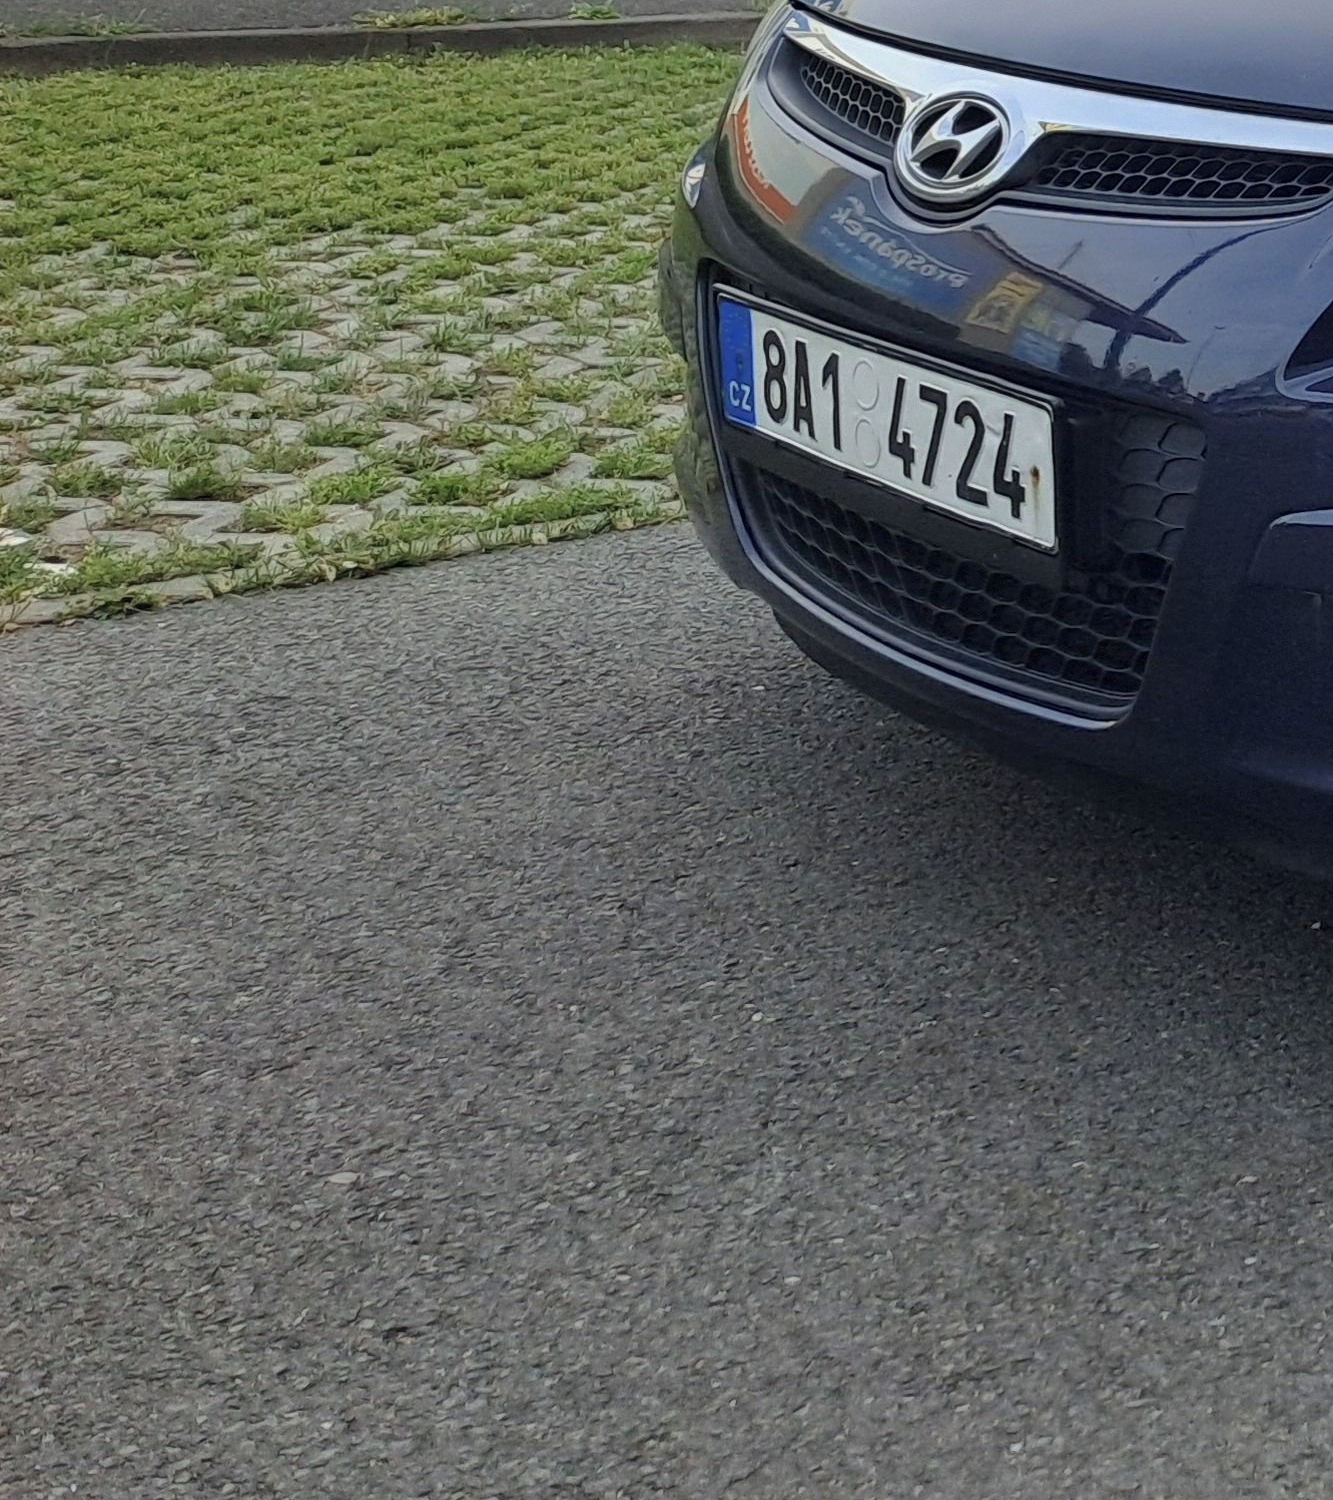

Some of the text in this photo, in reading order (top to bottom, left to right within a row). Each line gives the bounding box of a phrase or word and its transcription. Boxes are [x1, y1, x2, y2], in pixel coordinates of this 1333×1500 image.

[728, 381, 752, 412] CZ
[762, 329, 1027, 519] 8A1 4724
